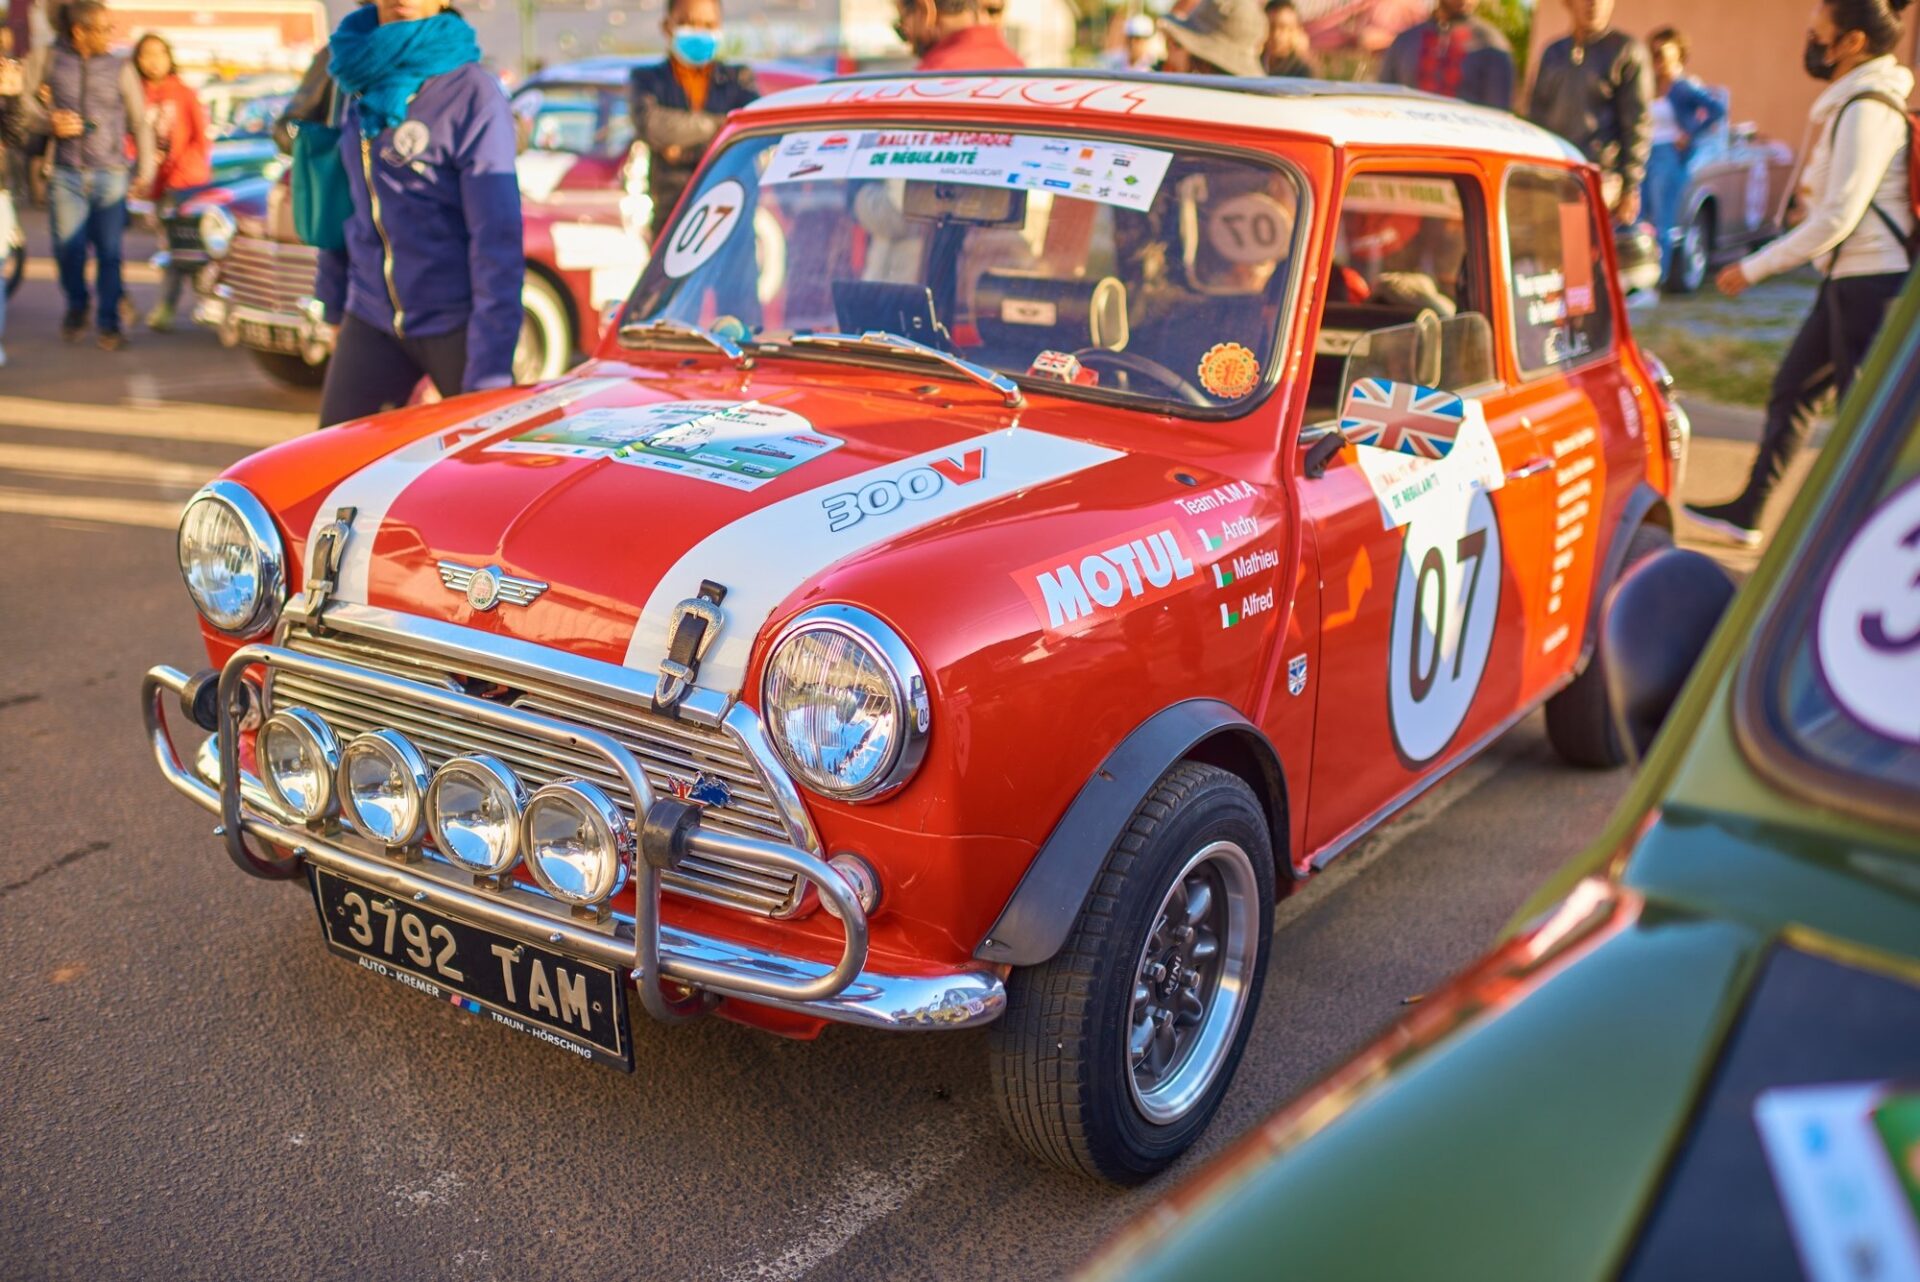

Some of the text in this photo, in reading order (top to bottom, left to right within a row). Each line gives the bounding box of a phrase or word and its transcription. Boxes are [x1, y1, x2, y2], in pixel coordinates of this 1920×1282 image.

[869, 151, 888, 166] DE
[878, 133, 927, 147] RALLYE
[677, 205, 734, 254] 07
[822, 446, 987, 532] 300V
[1174, 480, 1258, 516] Team A.M.A
[1221, 515, 1259, 541] Andry
[1036, 530, 1194, 629] MOTUL
[1232, 549, 1279, 580] Mathieu
[1241, 588, 1273, 619] Alfred
[1409, 528, 1487, 703] 07
[343, 891, 591, 1031] 3792 TAM
[358, 956, 386, 976] AUTO
[396, 972, 440, 998] KREMER
[1164, 955, 1182, 995] MINI
[491, 1011, 524, 1032] TRAUN
[532, 1027, 592, 1059] HÖRSCHING
